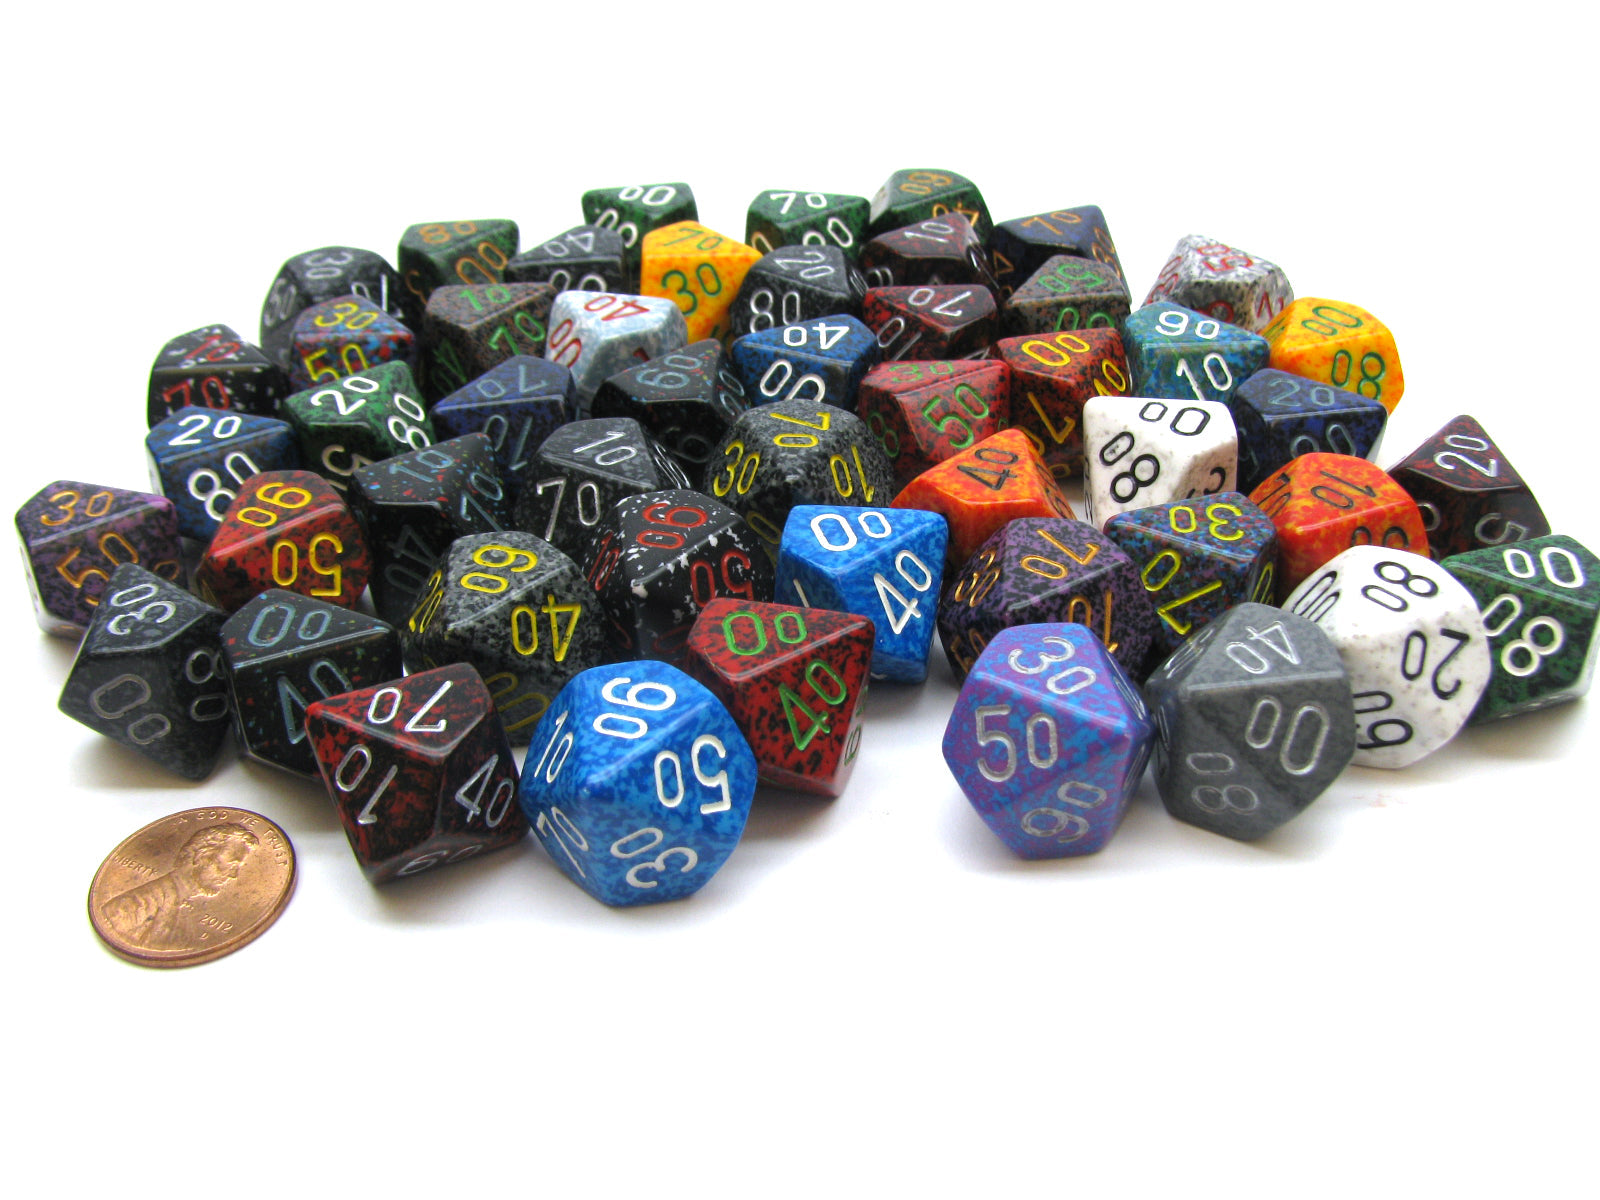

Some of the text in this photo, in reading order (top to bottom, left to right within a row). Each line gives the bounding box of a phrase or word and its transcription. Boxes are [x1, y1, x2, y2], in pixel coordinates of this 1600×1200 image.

[769, 191, 829, 215] 70
[1020, 210, 1083, 236] 70
[419, 220, 477, 245] 80
[543, 231, 595, 258] 40
[663, 226, 724, 251] 70
[903, 221, 954, 244] 10
[458, 284, 512, 311] 10
[583, 295, 651, 322] 40
[660, 261, 723, 316] 30
[749, 289, 801, 336] 80
[907, 287, 973, 317] 70
[313, 302, 380, 330] 30
[487, 311, 546, 356] 70
[783, 323, 850, 350] 40
[1155, 310, 1220, 340] 90
[1301, 305, 1364, 338] 00
[183, 333, 242, 362] 10
[889, 360, 955, 383] 30
[1021, 334, 1091, 367] 00
[161, 375, 230, 411] 70
[310, 376, 380, 416] 20
[475, 363, 550, 398] 70
[1176, 352, 1233, 401] 10
[1267, 379, 1335, 407] 20
[1330, 349, 1386, 401] 80
[167, 413, 243, 447] 20
[387, 391, 432, 452] 80
[769, 411, 832, 449] 70
[921, 382, 990, 449] 50
[1138, 402, 1212, 437] 00
[571, 430, 638, 466] 10
[713, 439, 762, 498] 30
[956, 447, 1019, 492] 40
[1099, 430, 1161, 505] 80
[1434, 433, 1498, 479] 20
[187, 451, 261, 521] 80
[829, 444, 876, 504] 10
[1310, 469, 1377, 510] 10
[41, 489, 114, 527] 30
[535, 476, 601, 543] 70
[810, 510, 893, 552] 00
[1168, 502, 1246, 542] 30
[56, 531, 139, 607] 50
[271, 531, 344, 597] 50
[585, 530, 622, 592] 10
[690, 547, 755, 609] 50
[954, 548, 1001, 608] 30
[1019, 529, 1101, 581] 70
[1502, 546, 1586, 589] 00
[107, 582, 177, 636] 30
[872, 548, 934, 636] 40
[1140, 549, 1224, 637] 70
[1373, 560, 1440, 613] 80
[247, 602, 333, 648] 00
[510, 593, 582, 663] 40
[721, 610, 809, 657] 00
[1224, 619, 1302, 675] 40
[1482, 592, 1566, 678] 80
[1007, 635, 1098, 695] 30
[1400, 626, 1471, 701] 20
[367, 680, 455, 733] 70
[778, 659, 848, 752] 40
[533, 709, 575, 785] 10
[975, 703, 1060, 784] 50
[1244, 695, 1331, 776] 00
[335, 743, 399, 826] 10
[455, 753, 515, 829] 40
[653, 733, 733, 816] 50
[1185, 751, 1260, 815] 80
[535, 805, 590, 879] 70
[609, 826, 699, 890] 30
[199, 913, 234, 933] 2012
